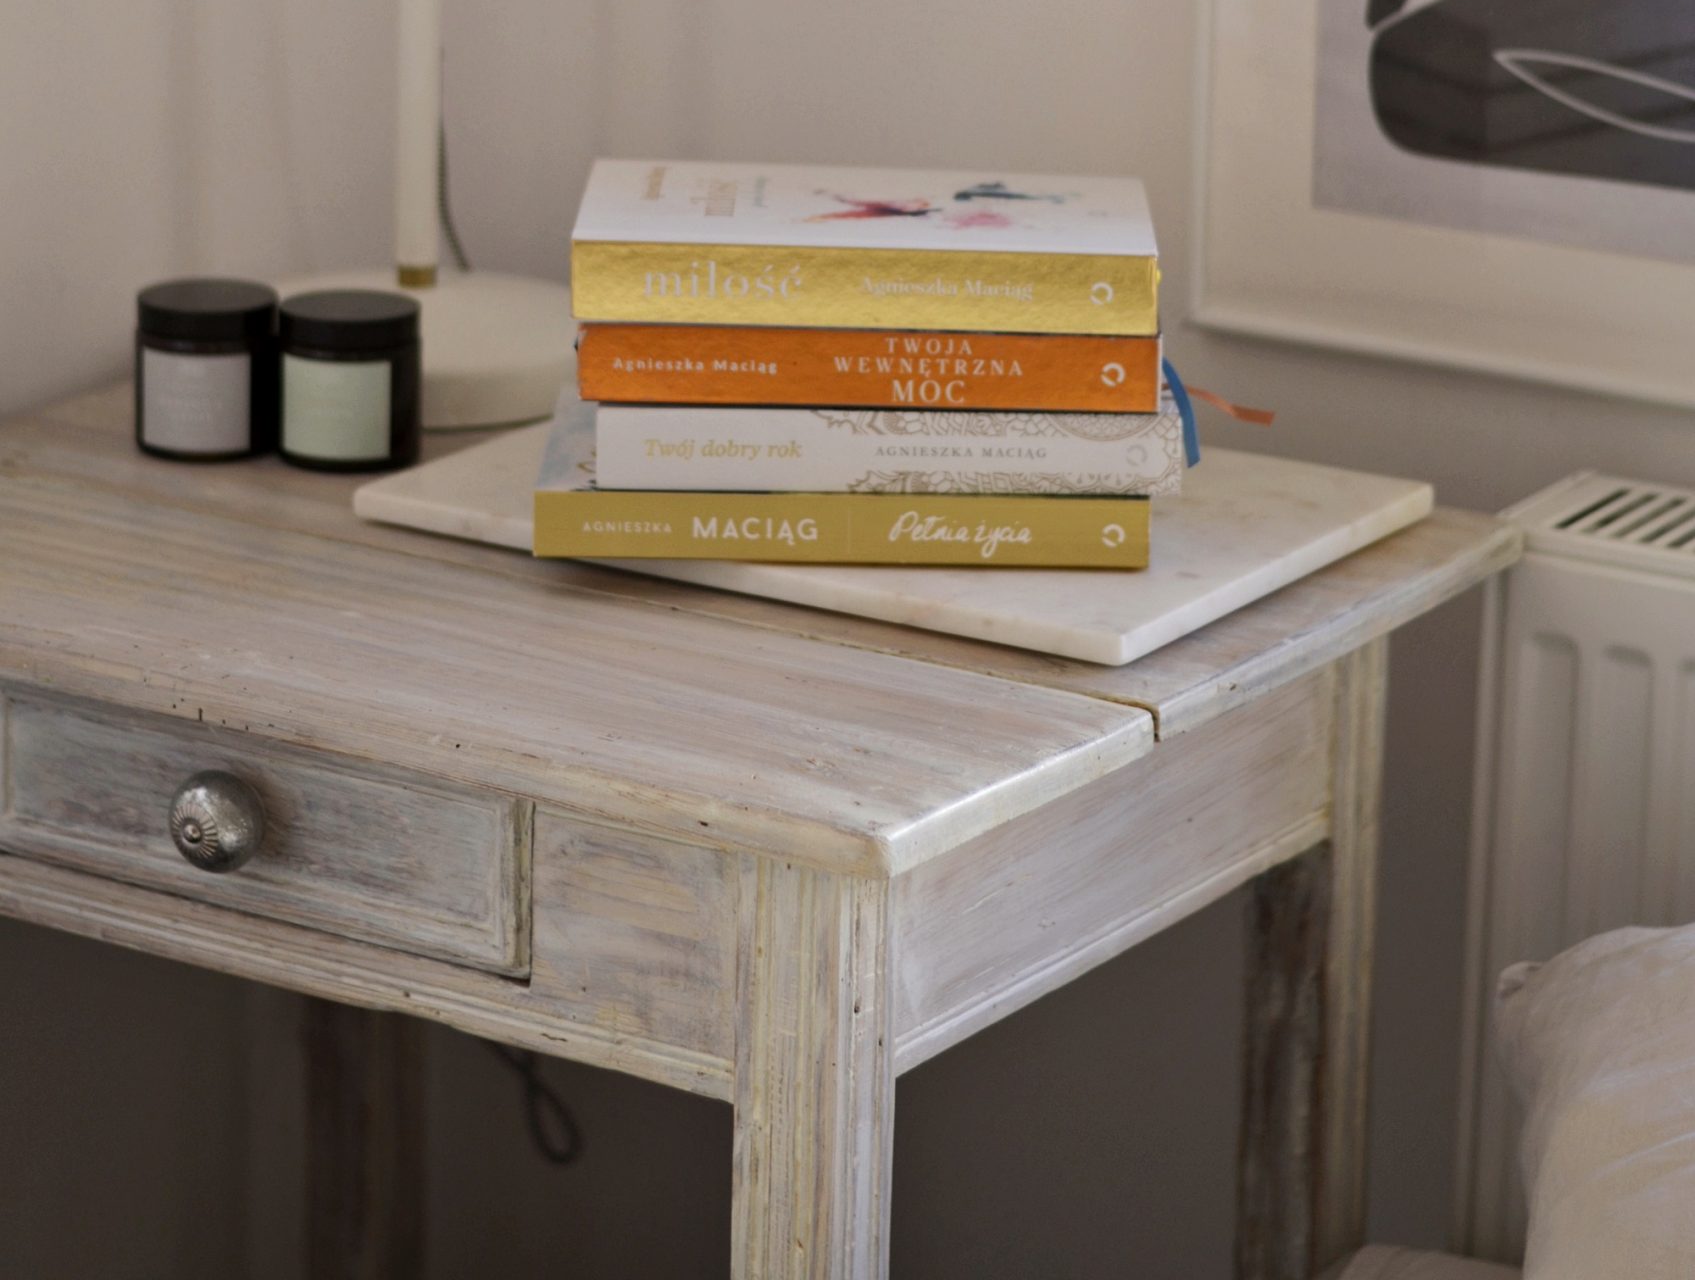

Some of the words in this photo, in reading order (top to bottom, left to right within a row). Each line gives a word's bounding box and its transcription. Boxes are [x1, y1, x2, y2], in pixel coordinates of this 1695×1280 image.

[861, 276, 958, 297] Agnieszka
[886, 337, 973, 355] TWOJA
[612, 357, 704, 372] Agnieszka
[834, 356, 1024, 377] WEWNĘTRZNA
[892, 379, 966, 403] MOC
[643, 438, 696, 460] Twój
[702, 439, 762, 460] dobry
[767, 440, 803, 458] rok
[875, 446, 973, 458] AGNIESZKA
[981, 447, 1047, 461] MACIĄG
[582, 522, 673, 534] AGNIESZKA
[692, 517, 819, 545] MACIĄG
